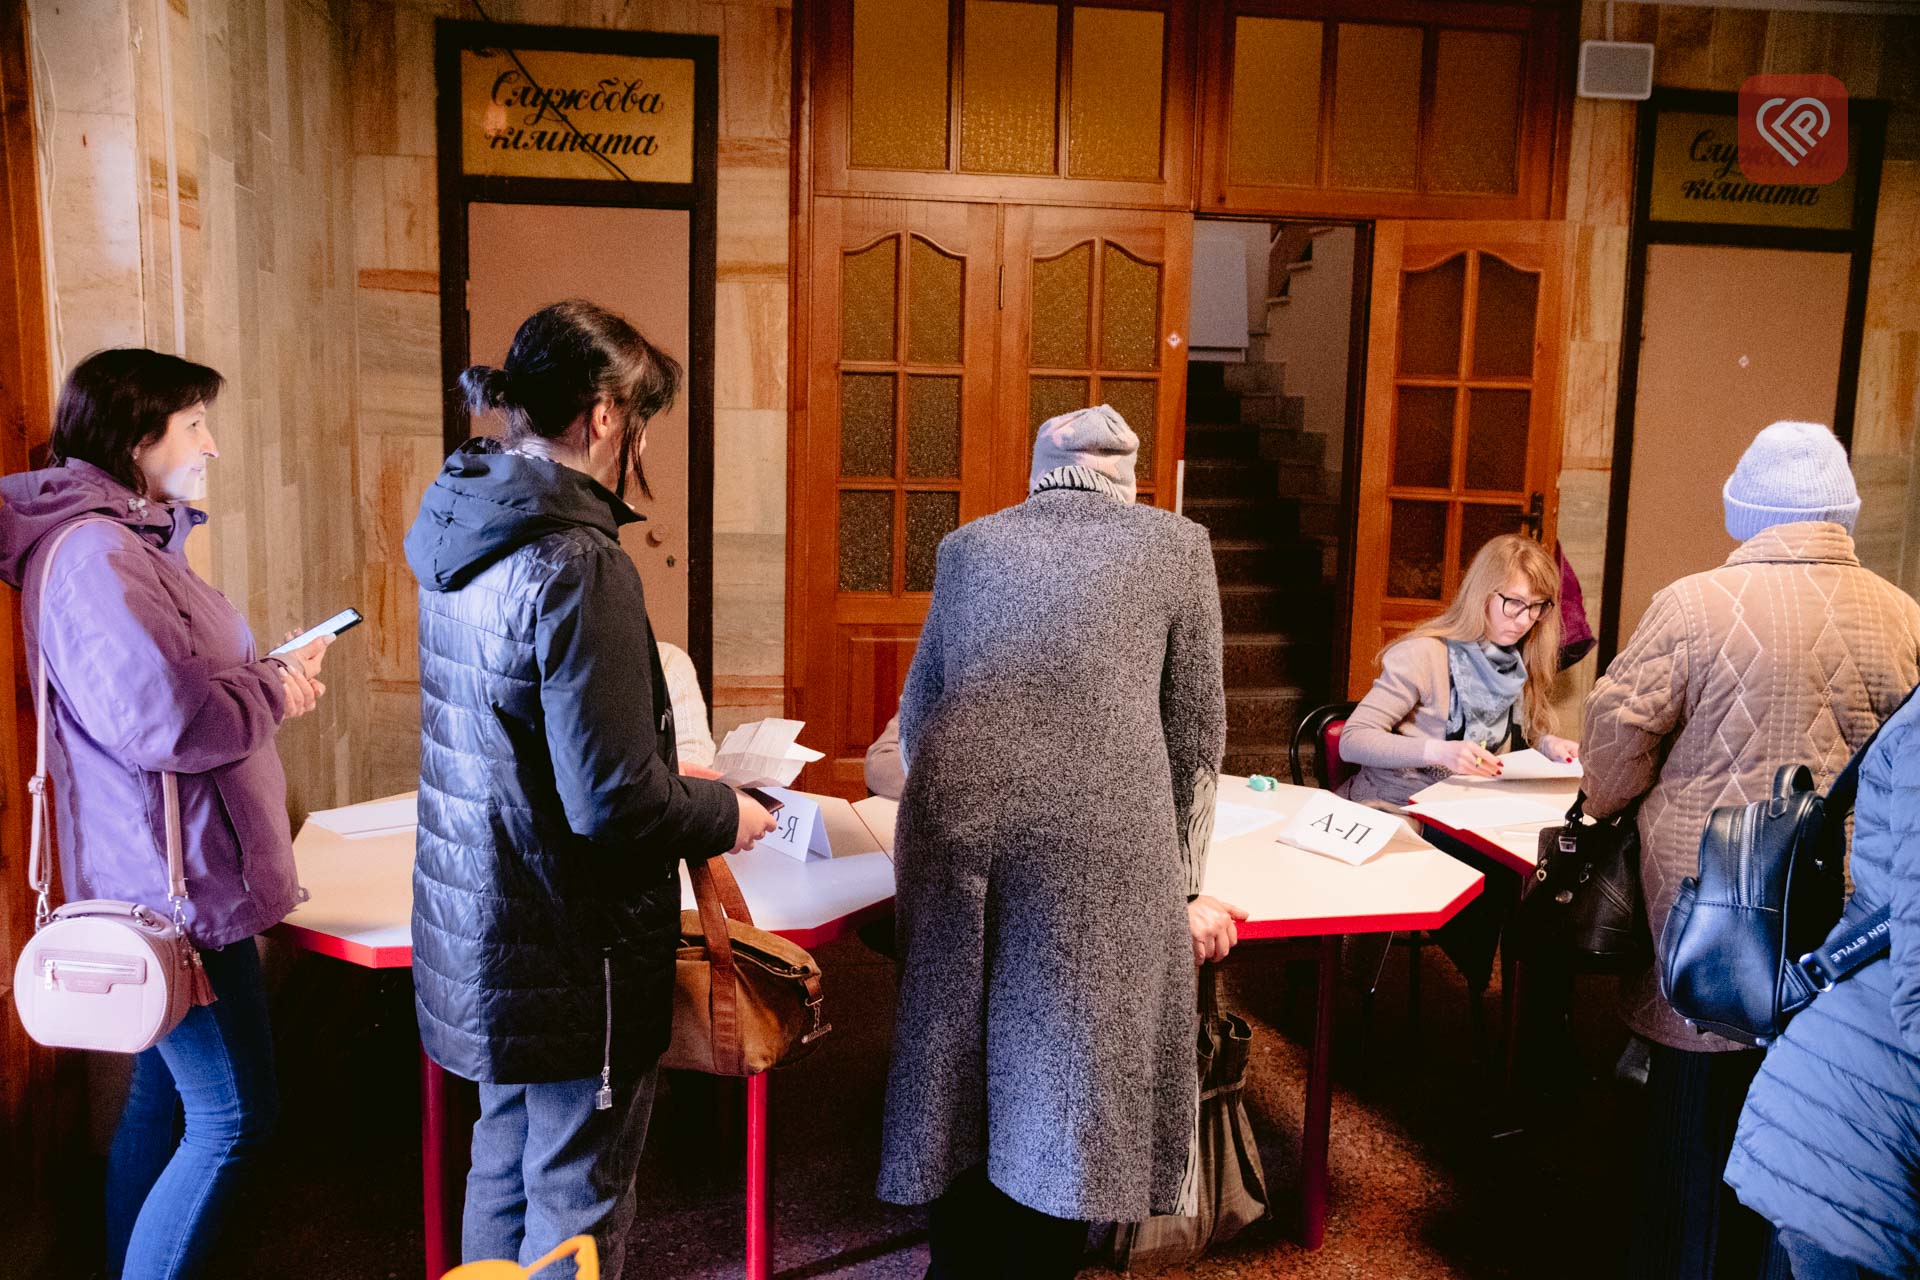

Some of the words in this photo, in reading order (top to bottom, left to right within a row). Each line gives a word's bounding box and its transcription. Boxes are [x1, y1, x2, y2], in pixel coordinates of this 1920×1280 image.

[491, 70, 664, 126] Службова
[1680, 178, 1820, 206] кімната
[1310, 813, 1373, 844] А-П
[1867, 918, 1892, 940] ION
[1830, 935, 1868, 963] STYLE
